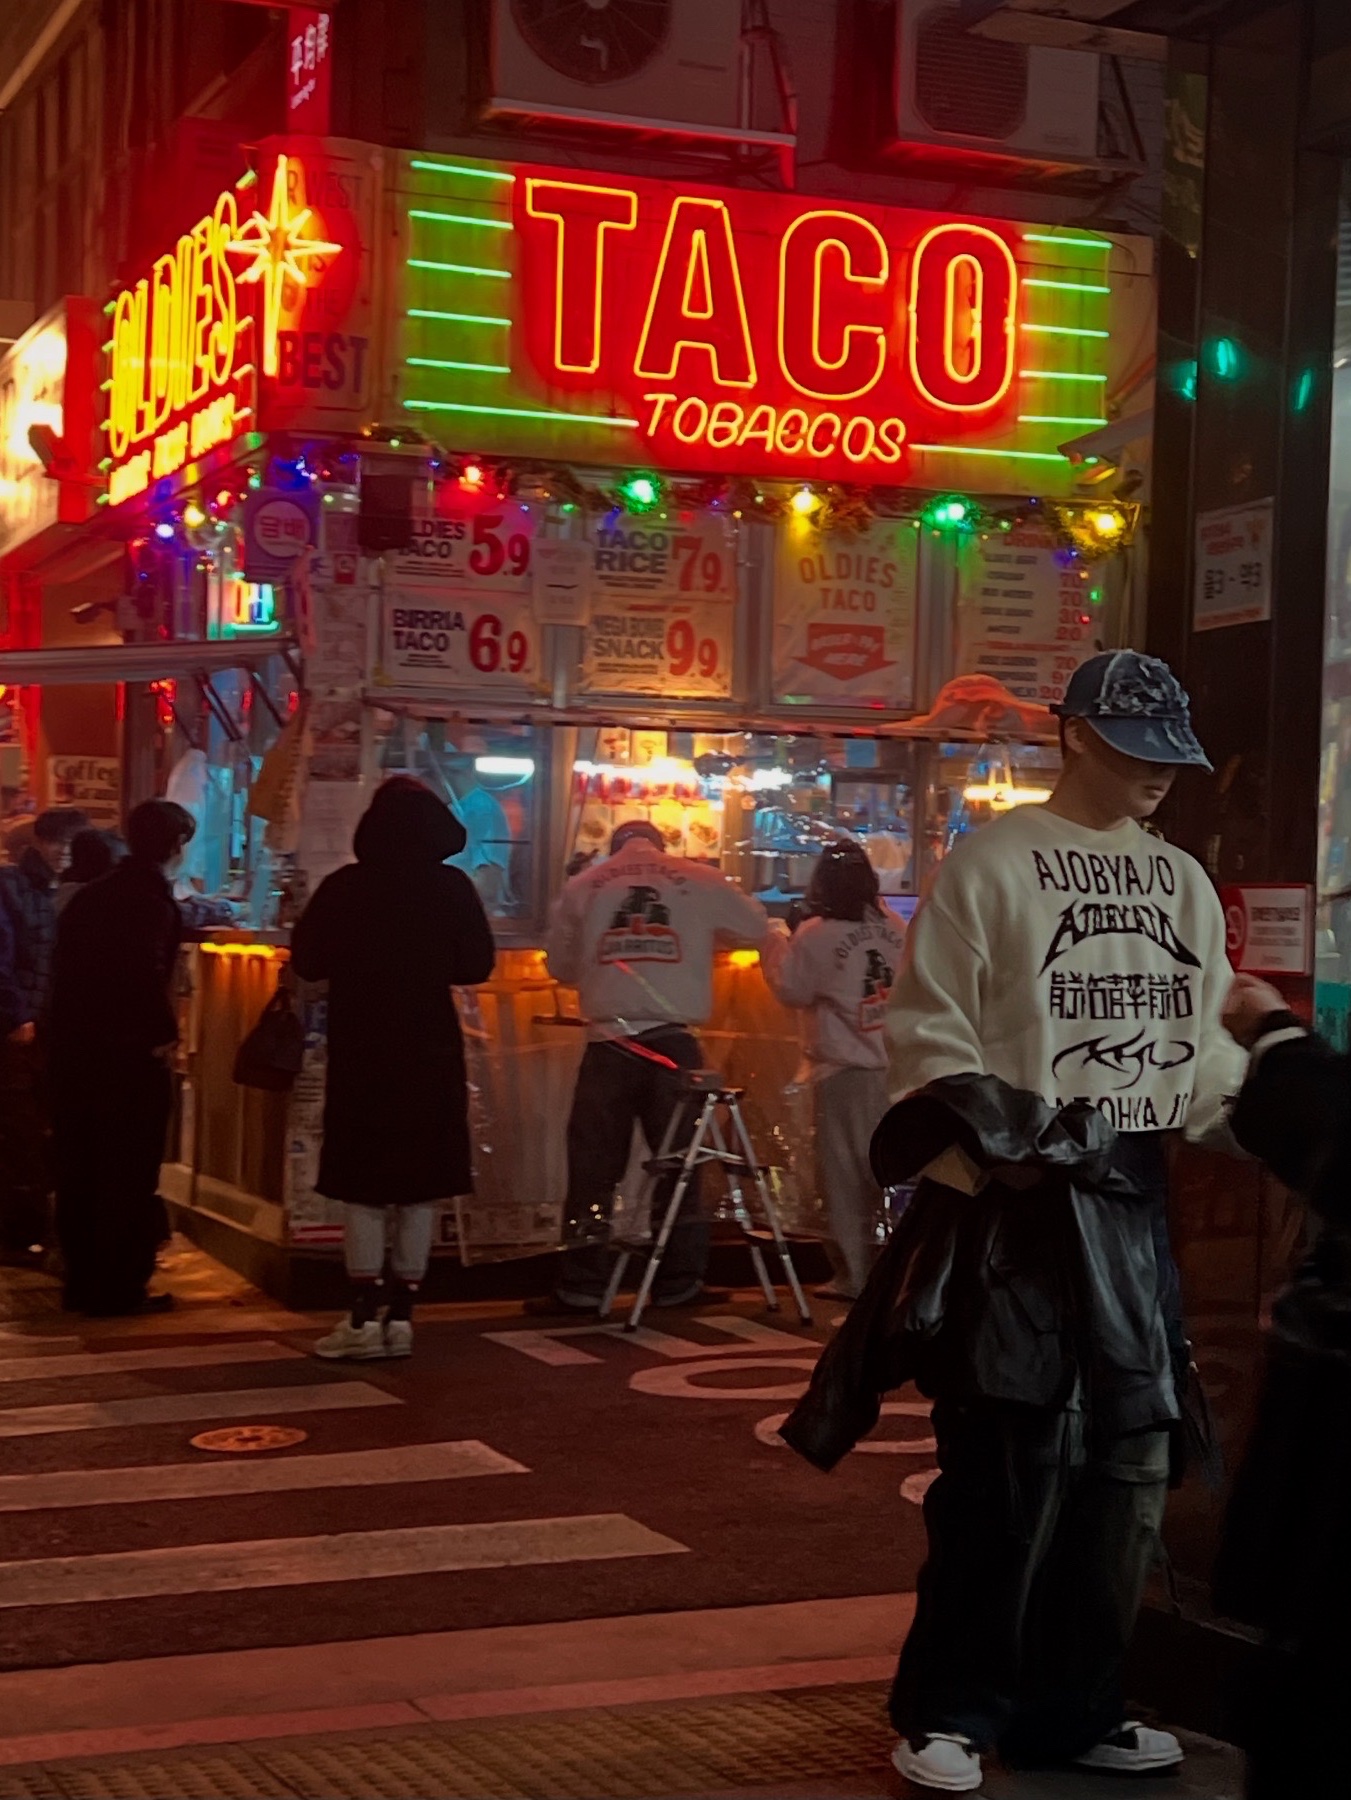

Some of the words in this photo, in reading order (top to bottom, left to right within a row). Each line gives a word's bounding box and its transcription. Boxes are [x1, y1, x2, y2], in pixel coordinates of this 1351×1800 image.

[525, 178, 1019, 413] TACO
[109, 190, 238, 458] OLDIES
[277, 329, 368, 393] BEST
[643, 392, 907, 463] TOBACCOS
[597, 529, 669, 551] TACO
[595, 550, 668, 574] RICE
[799, 552, 898, 588] OLDIES
[818, 587, 876, 612] TACO
[392, 608, 465, 631] BIRRIA
[392, 630, 451, 652] TACO
[593, 637, 664, 660] SNACK
[1031, 848, 1175, 896] AJOBYAJO
